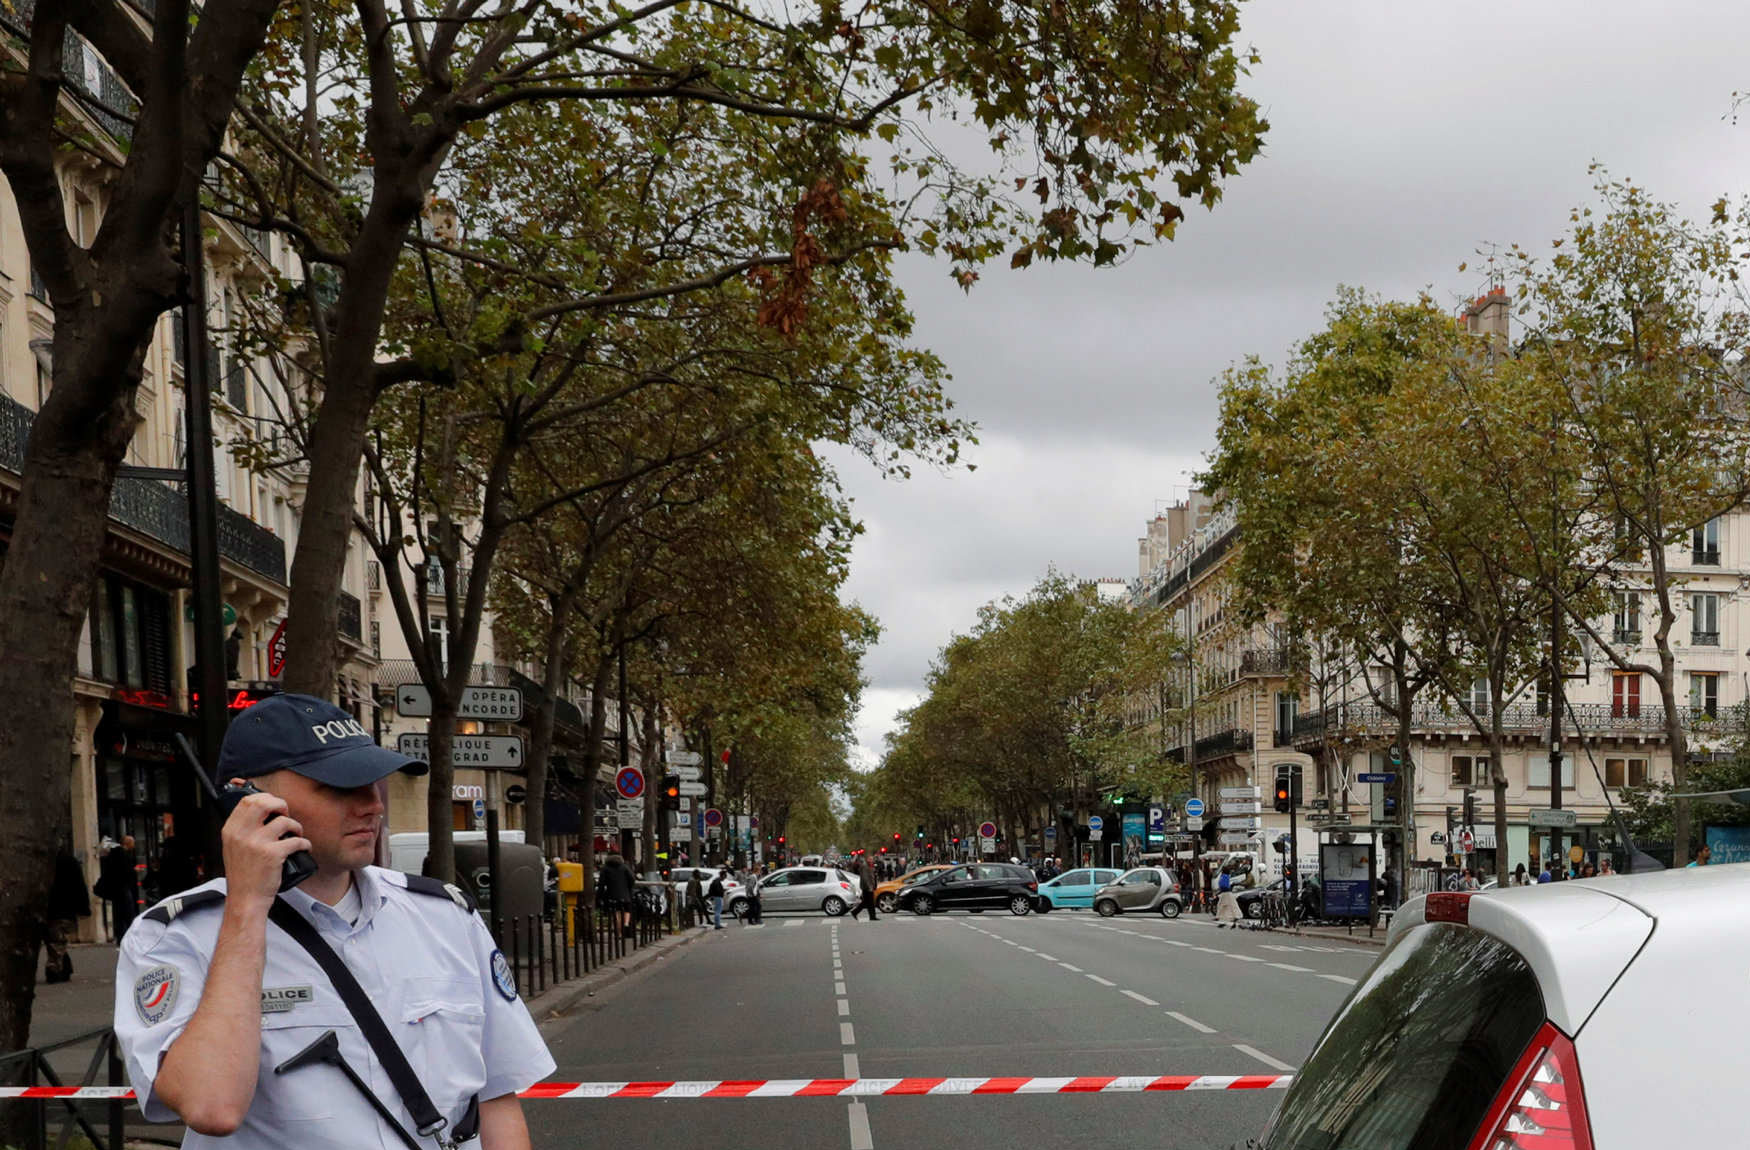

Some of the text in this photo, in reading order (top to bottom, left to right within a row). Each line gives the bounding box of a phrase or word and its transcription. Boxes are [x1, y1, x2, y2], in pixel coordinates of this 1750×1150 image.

[273, 630, 286, 666] TABAC
[471, 690, 516, 703] OPÉRA
[462, 704, 517, 715] NCORDE
[312, 718, 372, 744] POLIC
[404, 738, 491, 750] RÉPLIQUE
[404, 752, 489, 762] STAGRAD
[1391, 747, 1400, 755] BU
[1150, 809, 1162, 825] P
[142, 968, 166, 982] POLICE
[136, 972, 174, 993] NATIONALE
[262, 989, 307, 1000] LICE
